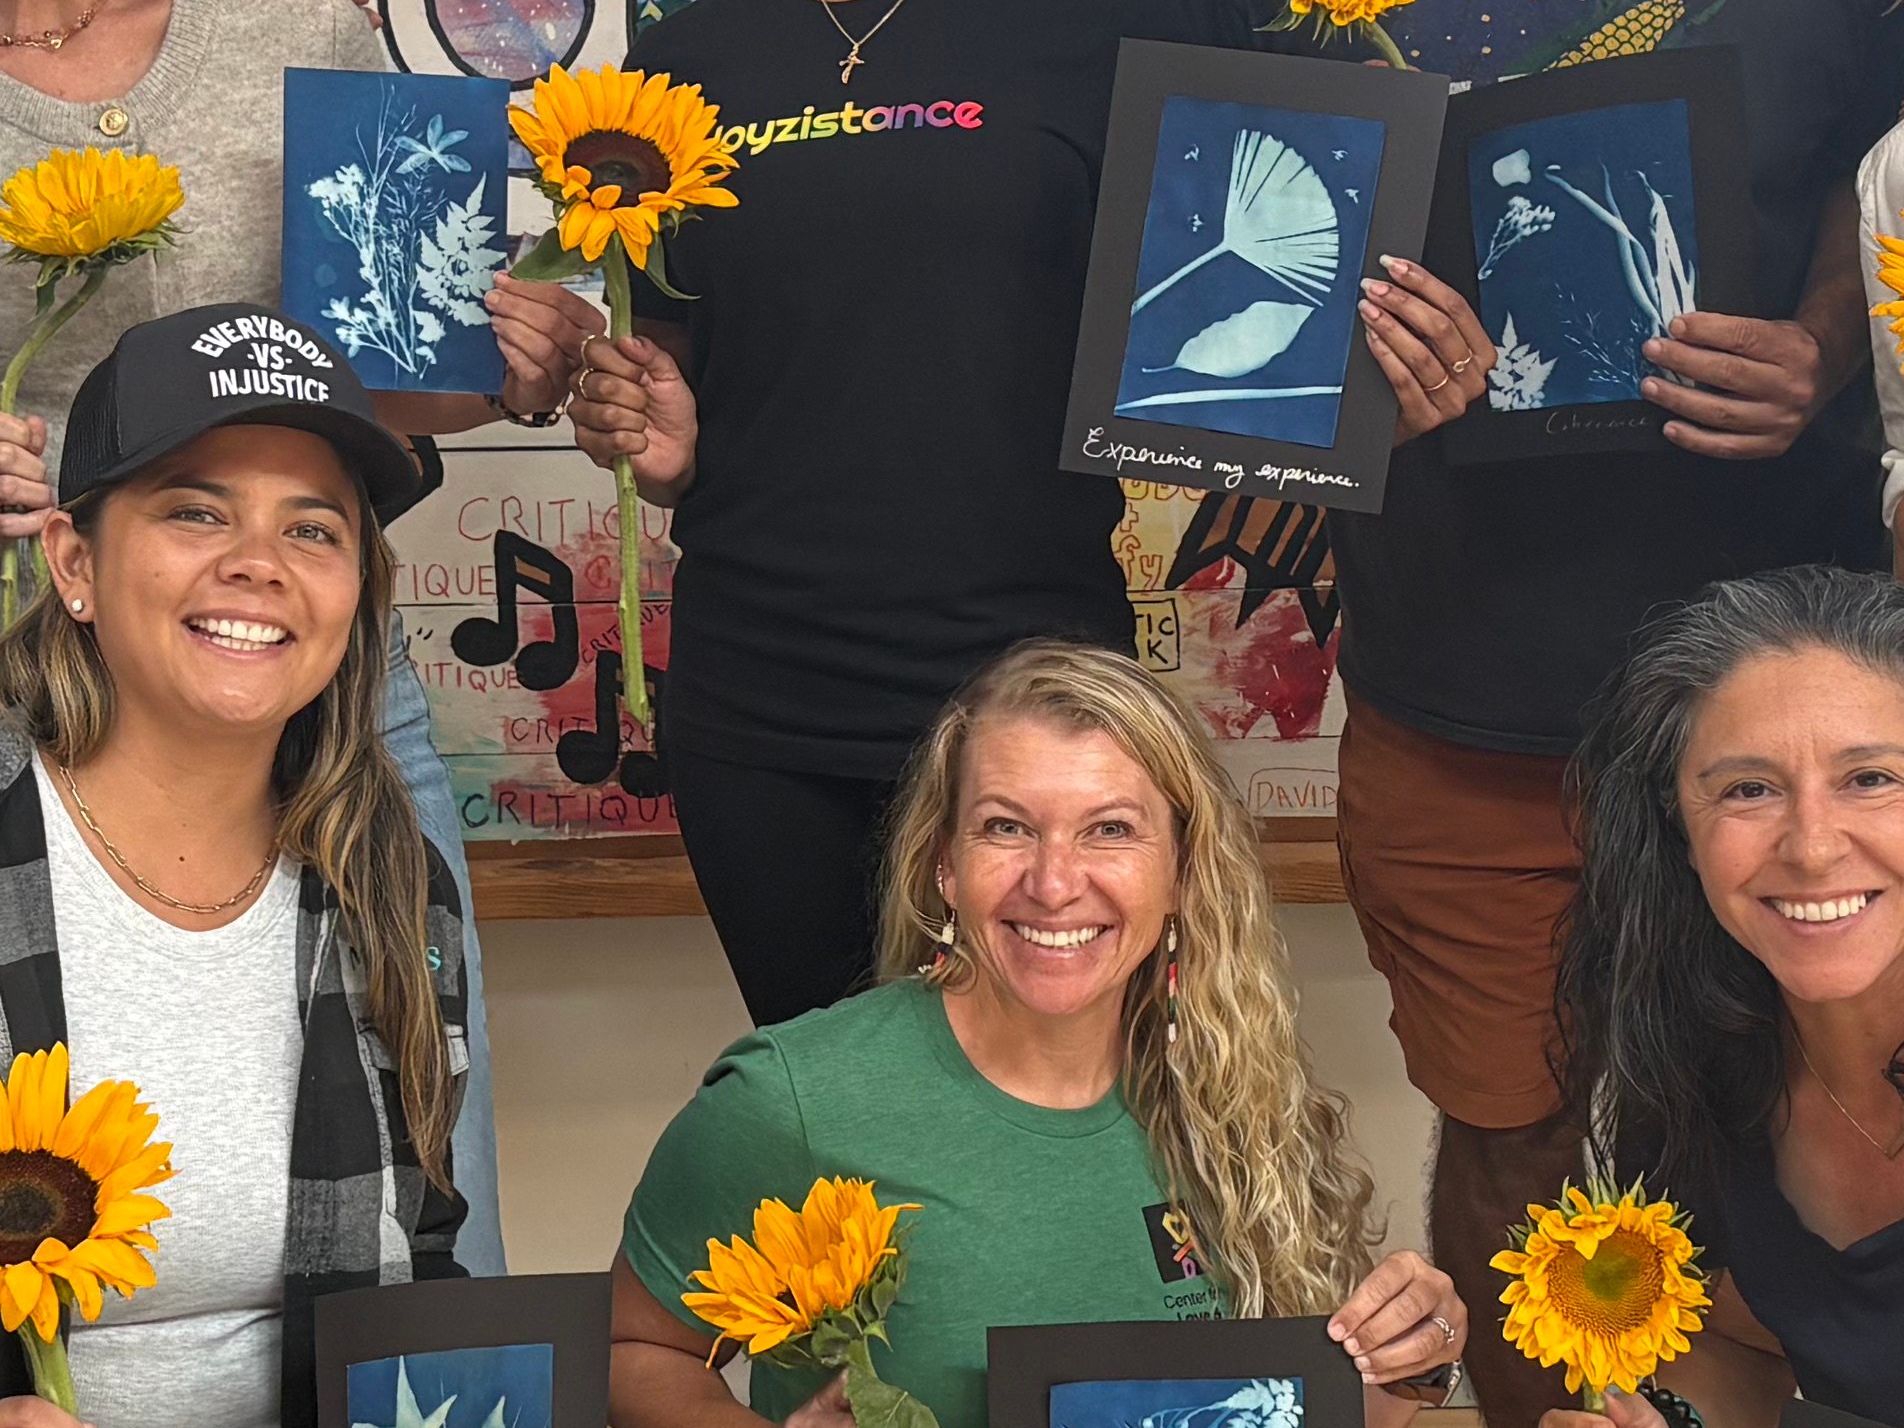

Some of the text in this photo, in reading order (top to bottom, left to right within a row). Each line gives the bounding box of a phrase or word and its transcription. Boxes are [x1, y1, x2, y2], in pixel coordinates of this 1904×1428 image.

[191, 315, 334, 369] EVERYBODY
[209, 369, 330, 403] INJUSTICE
[1082, 427, 1202, 471] Experience
[1213, 461, 1246, 489] my
[412, 658, 521, 693] ITIQUE
[1163, 1291, 1207, 1309] Center
